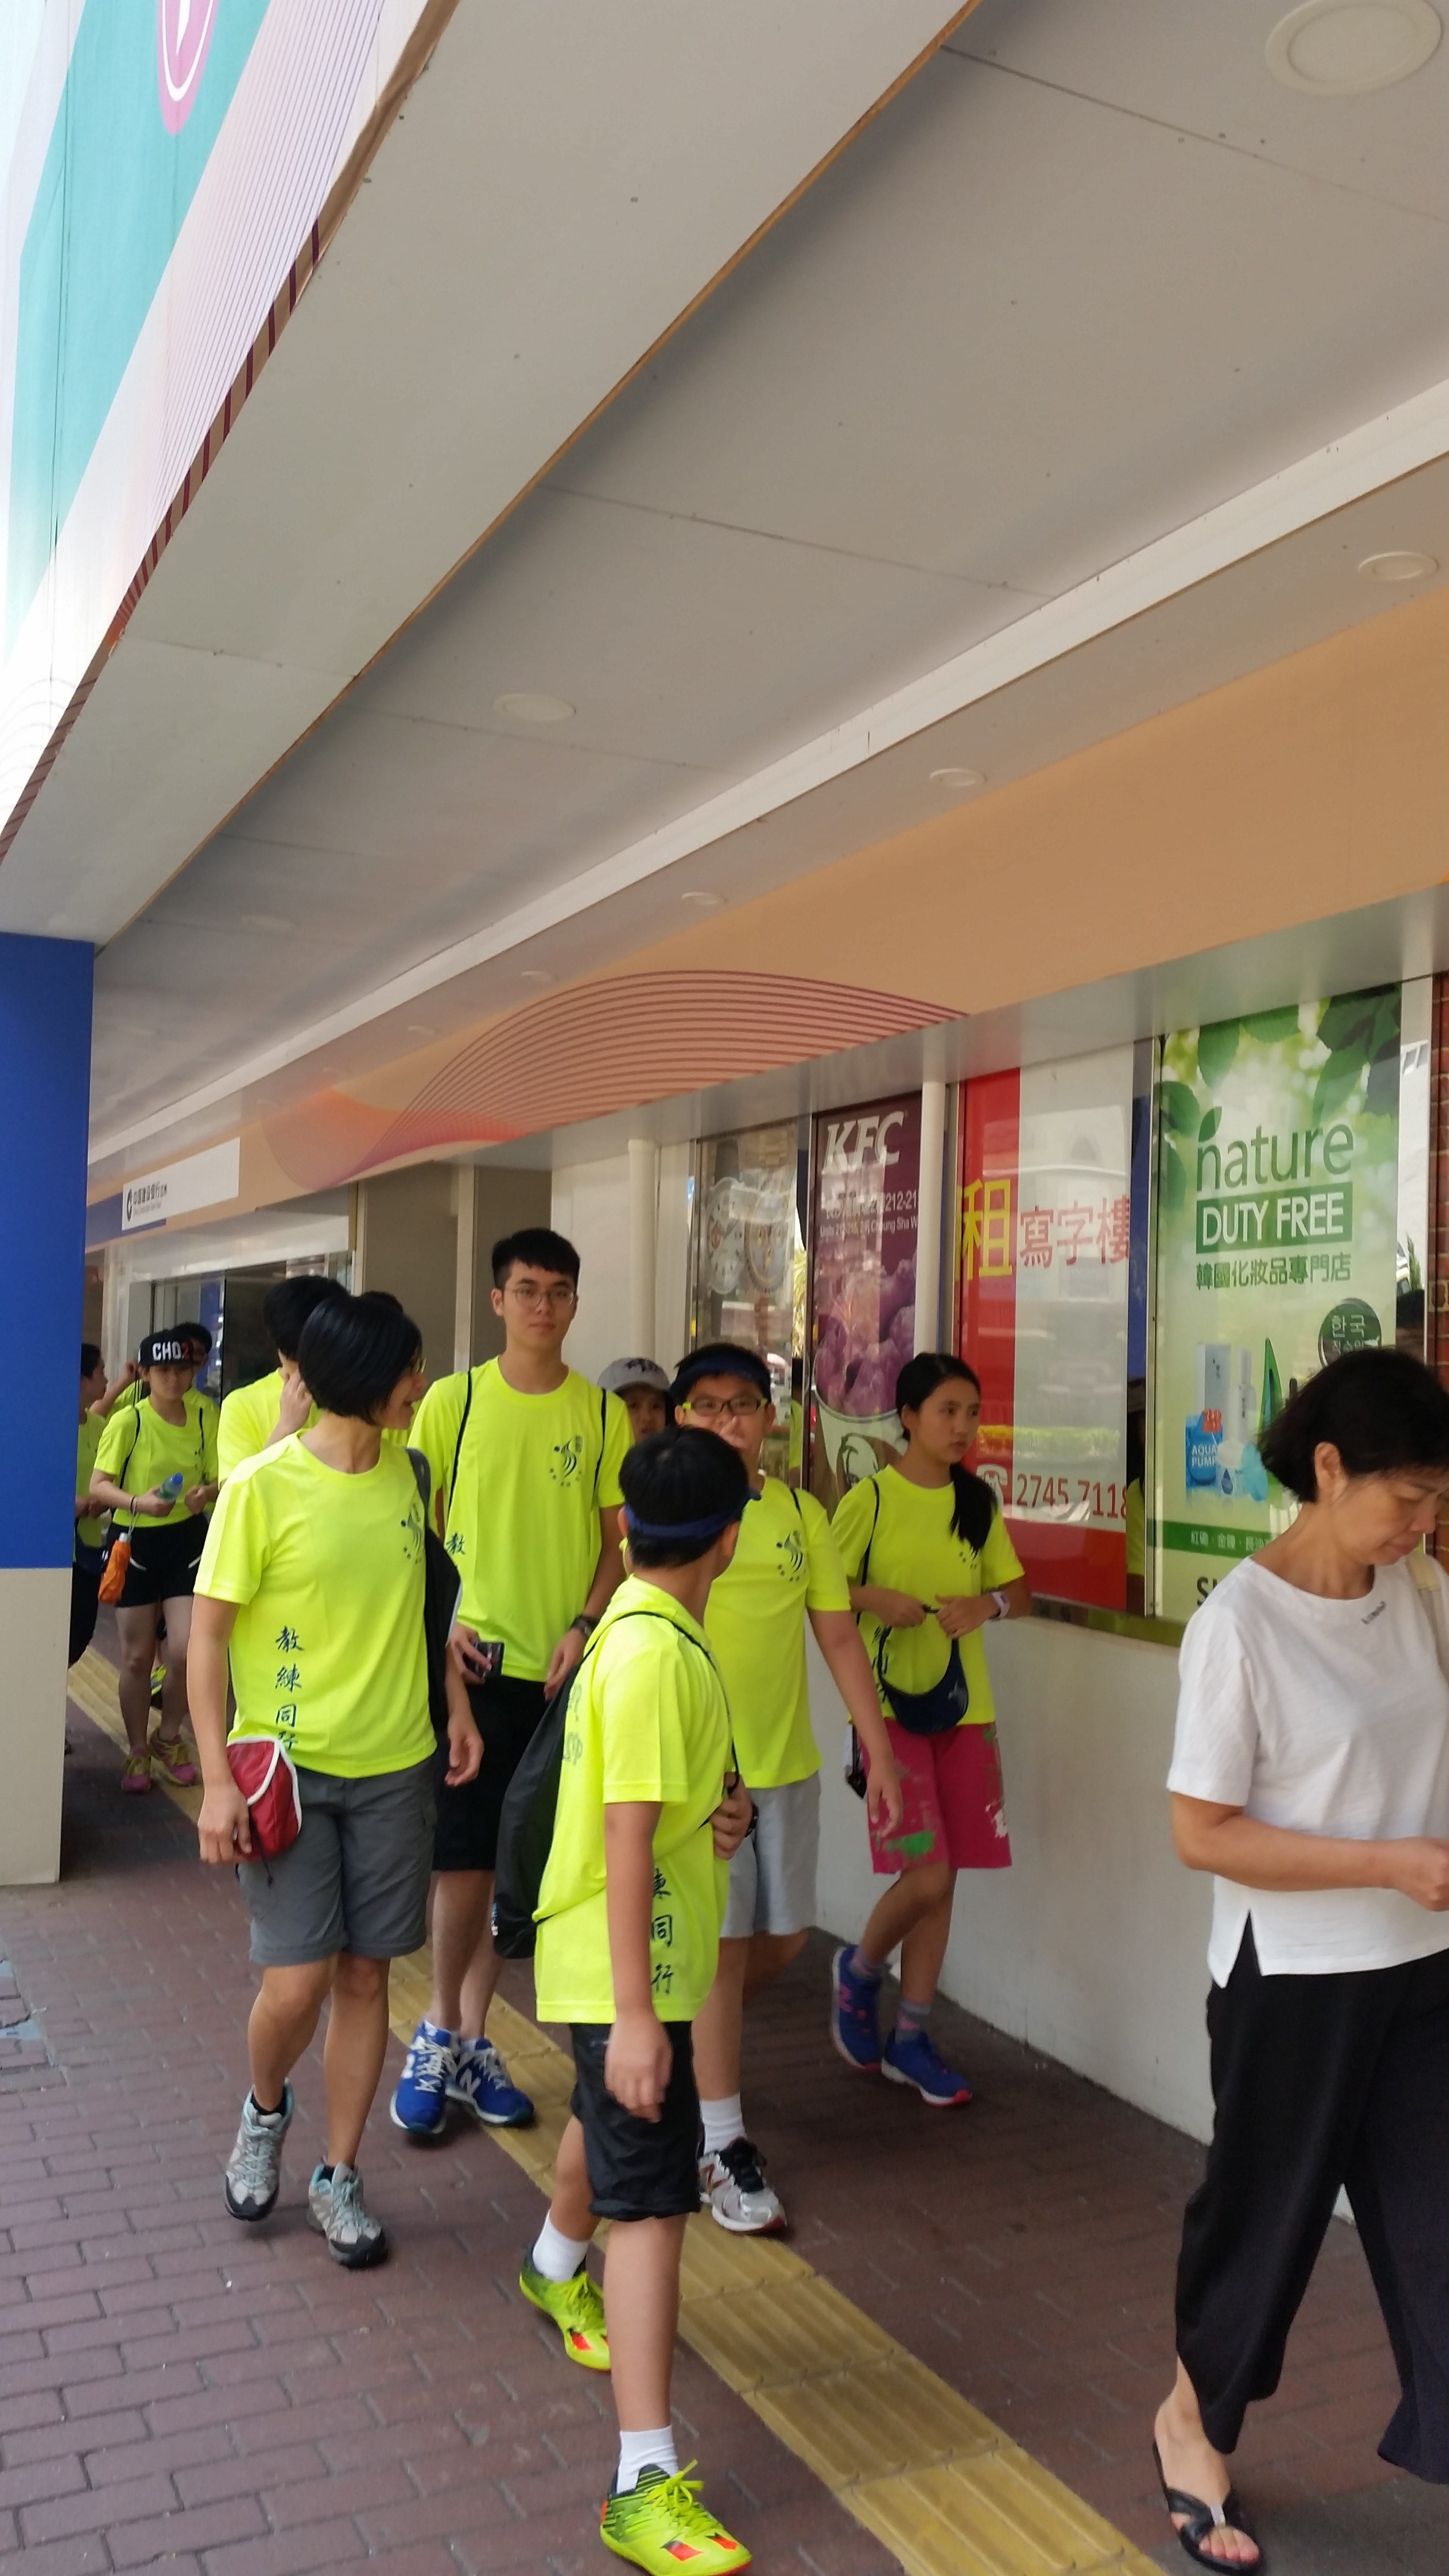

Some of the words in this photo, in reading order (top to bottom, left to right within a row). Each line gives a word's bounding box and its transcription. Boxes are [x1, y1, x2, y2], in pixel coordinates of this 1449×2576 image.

[821, 1111, 904, 1175] KFC
[1196, 1123, 1354, 1191] nature
[962, 1178, 1012, 1281] 租
[1020, 1194, 1129, 1268] 寫字樓
[1202, 1199, 1269, 1246] DUTY
[1276, 1191, 1344, 1240] FREE
[1195, 1251, 1352, 1290] 韓國化妝品專門店
[1332, 1314, 1366, 1338] 한국
[1191, 1444, 1217, 1456] AQUA
[1016, 1473, 1069, 1508] 2745
[446, 1532, 467, 1555] 教
